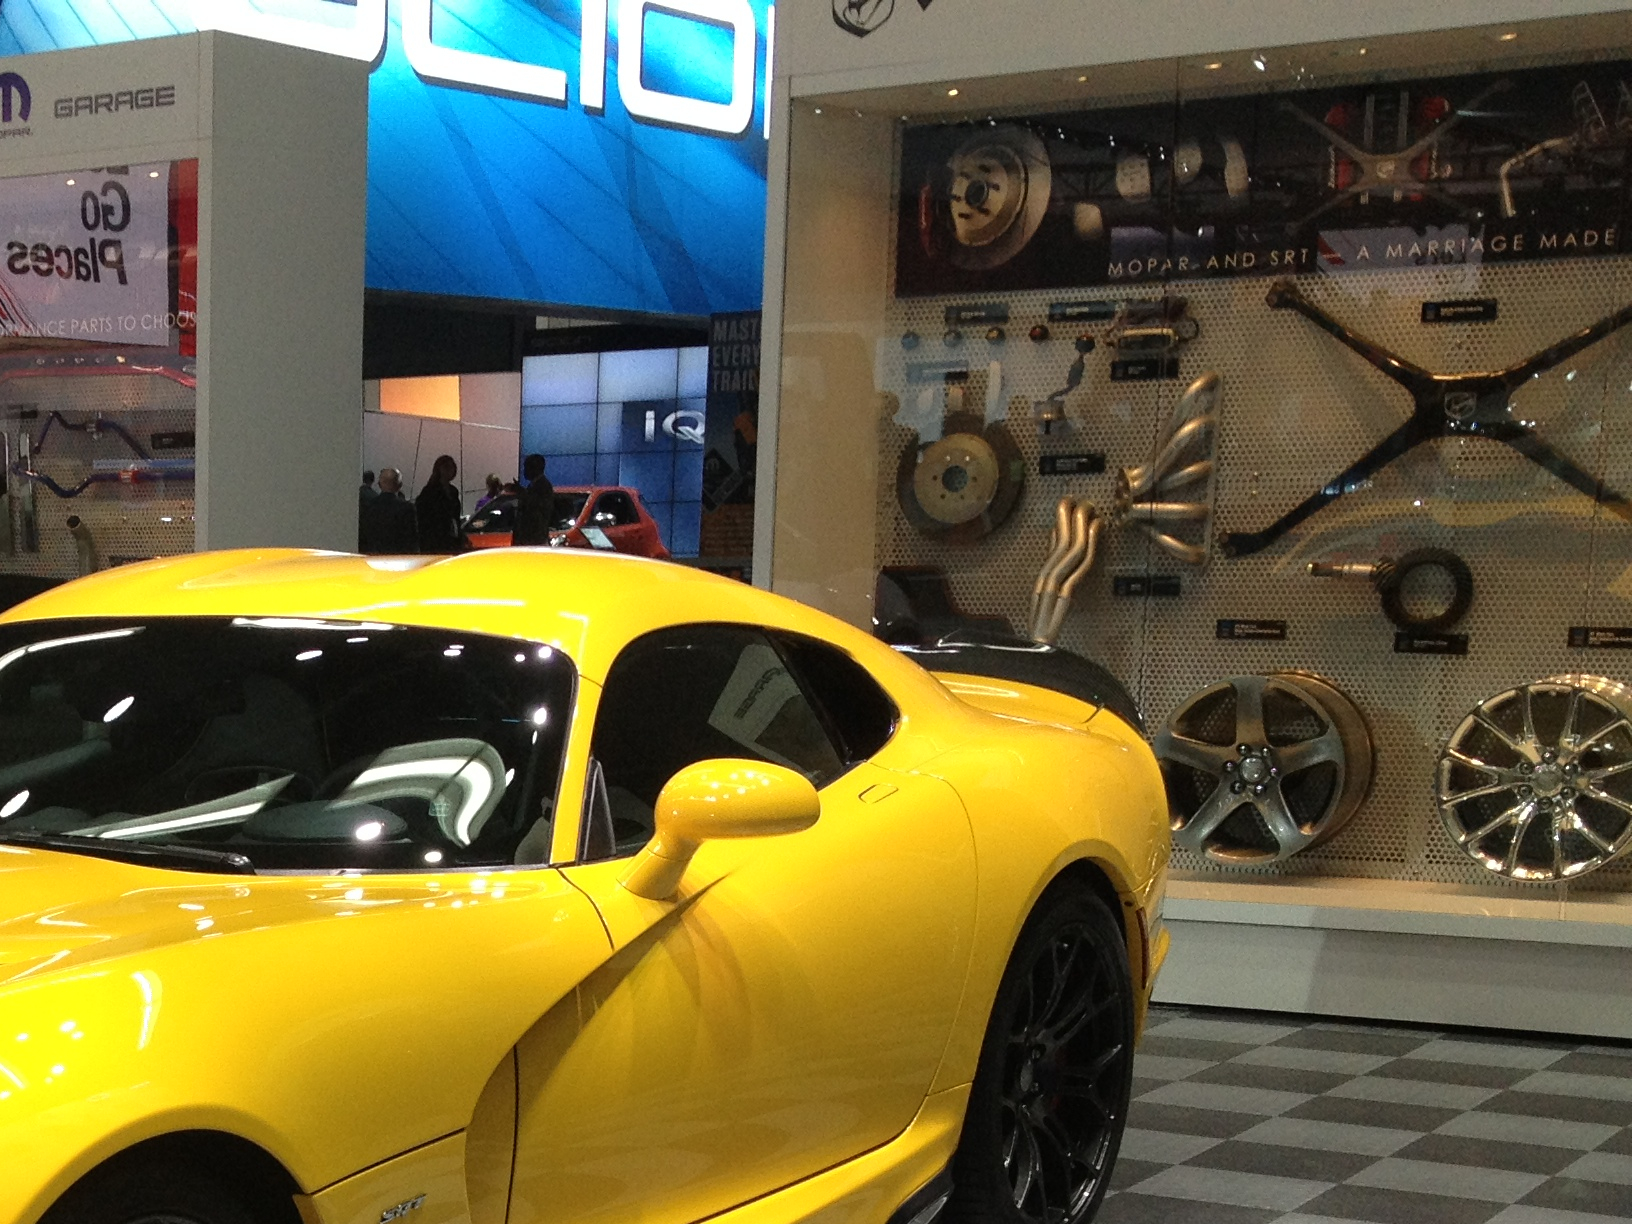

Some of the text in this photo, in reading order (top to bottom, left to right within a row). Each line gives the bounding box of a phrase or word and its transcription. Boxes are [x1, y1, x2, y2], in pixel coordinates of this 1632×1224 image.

[54, 85, 176, 119] GARAGE
[1107, 256, 1189, 277] MOPAR
[1206, 251, 1255, 269] AND
[1270, 248, 1309, 266] SRT
[1356, 245, 1370, 261] A
[1385, 234, 1524, 259] MARRIAGE
[1539, 228, 1616, 250] MADE
[70, 316, 113, 334] PARTS
[118, 314, 136, 332] TO
